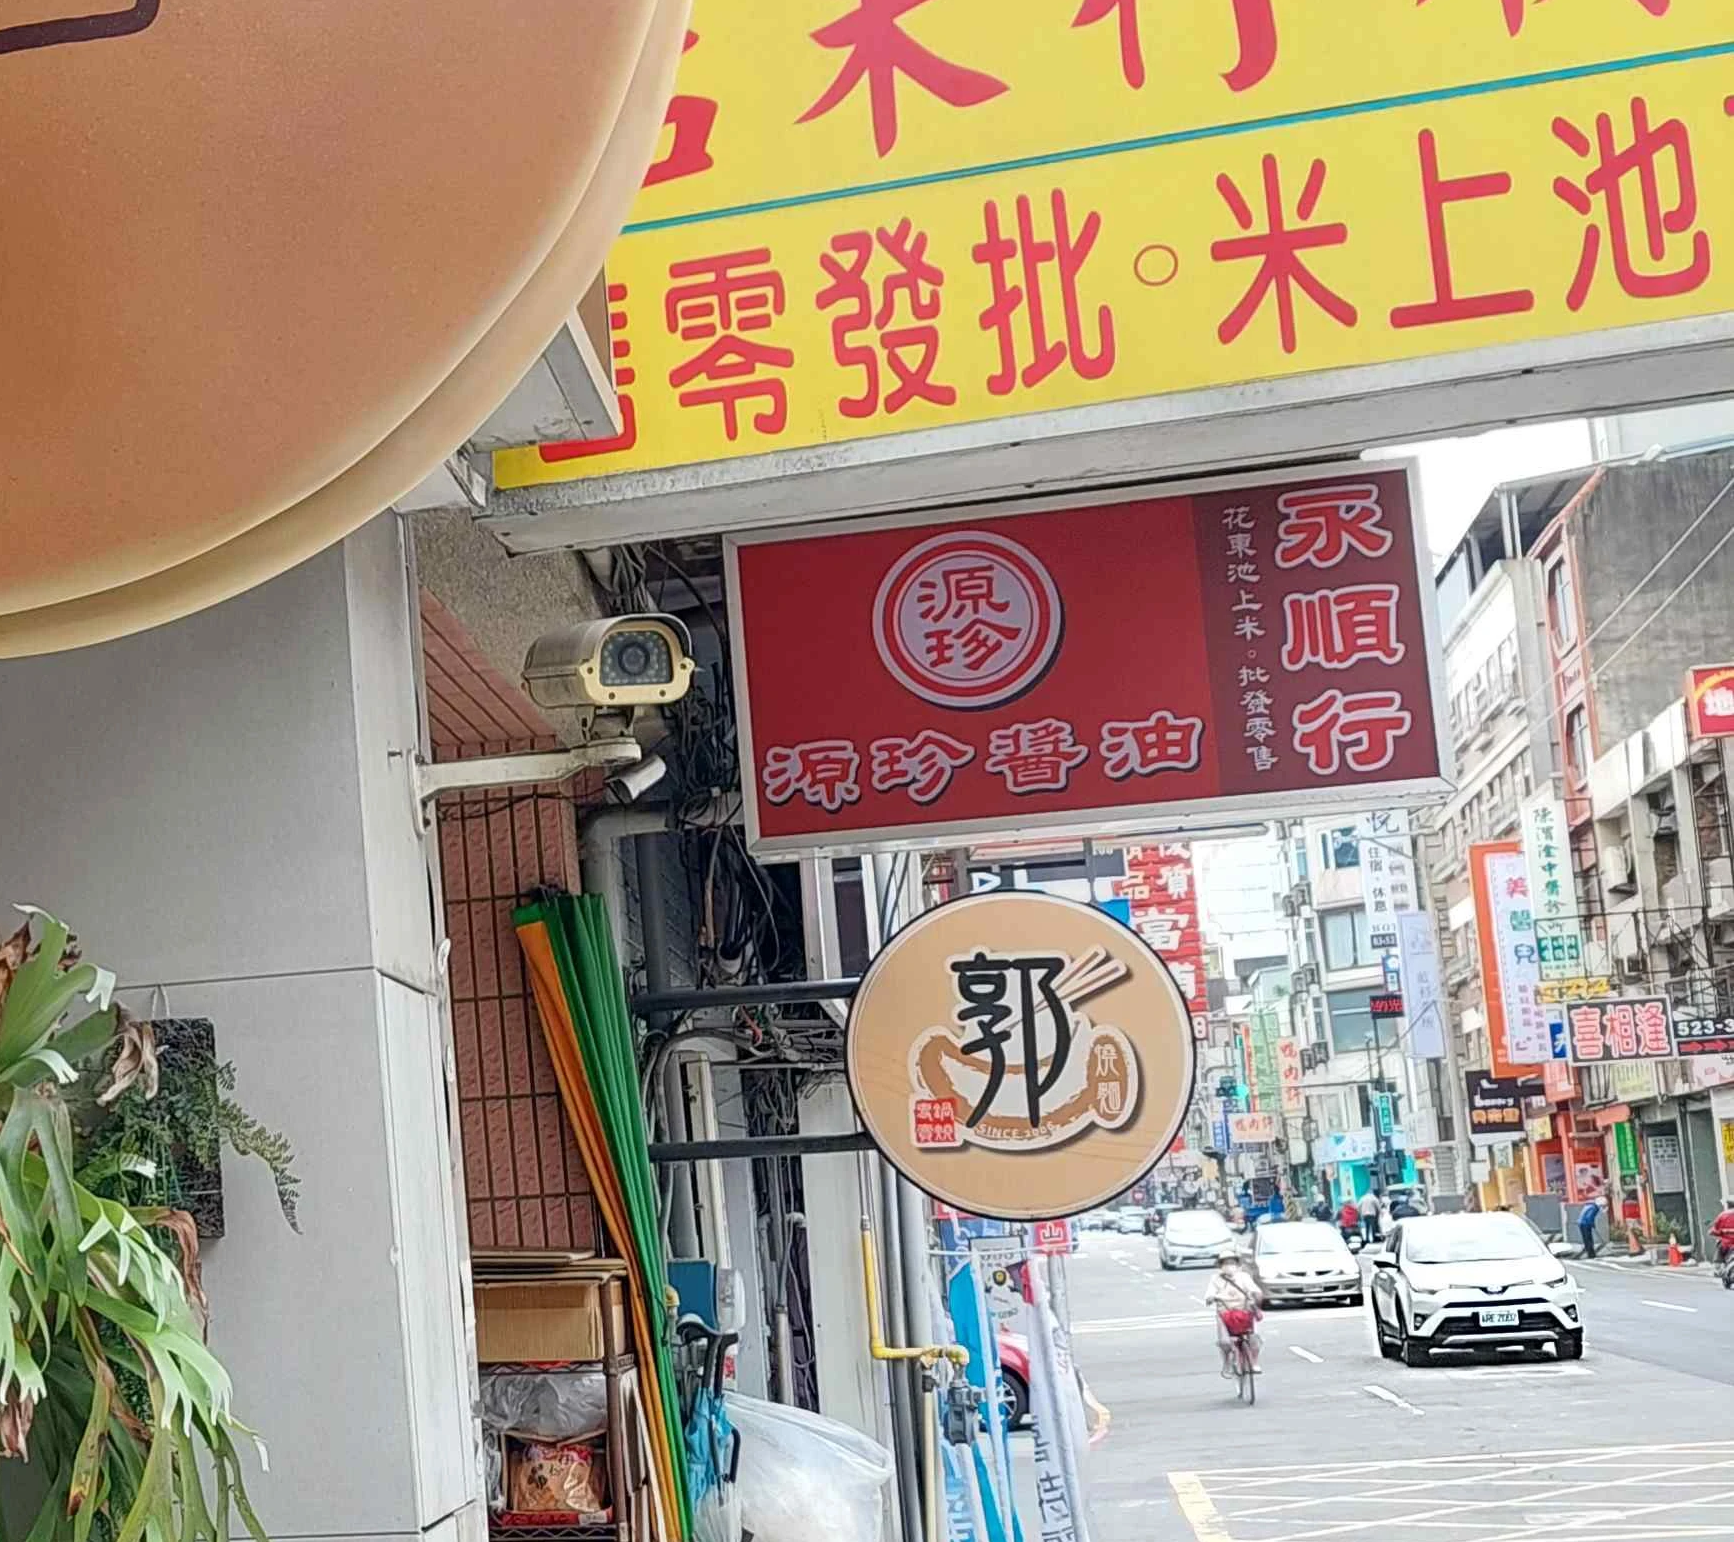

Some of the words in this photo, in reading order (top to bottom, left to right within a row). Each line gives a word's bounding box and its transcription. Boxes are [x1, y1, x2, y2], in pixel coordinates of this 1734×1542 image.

[915, 563, 1022, 671] 源珍
[764, 708, 1205, 811] 源珍醬油
[950, 952, 1072, 1129] 郭
[1569, 1001, 1671, 1059] 喜相逢
[975, 1123, 1024, 1141] SINCE
